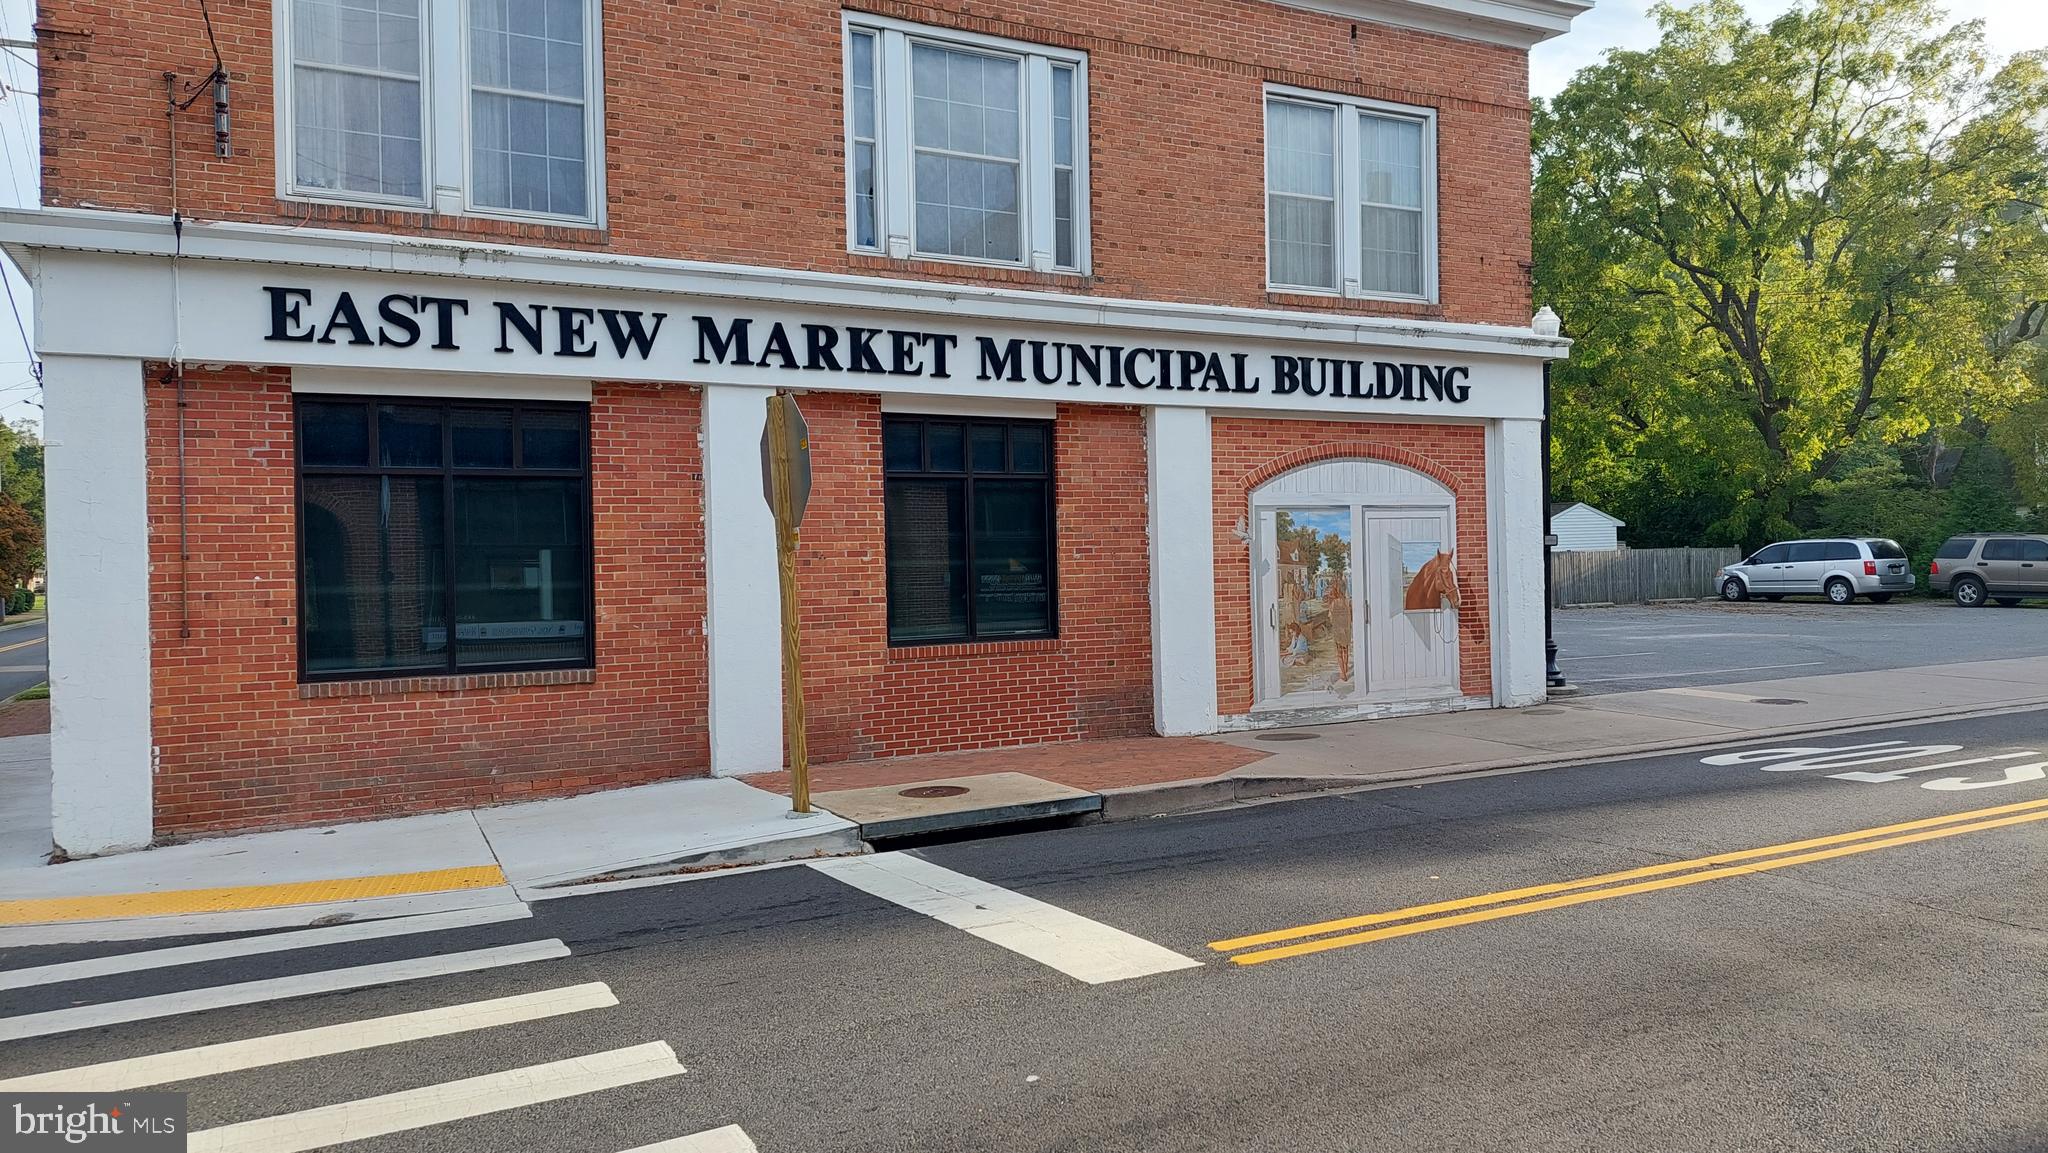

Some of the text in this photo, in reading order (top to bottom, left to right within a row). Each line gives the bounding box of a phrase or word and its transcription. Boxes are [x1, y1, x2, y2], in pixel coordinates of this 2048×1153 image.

[262, 286, 1471, 404] EAST NEW MARKET MUNICIPAL BUILDING
